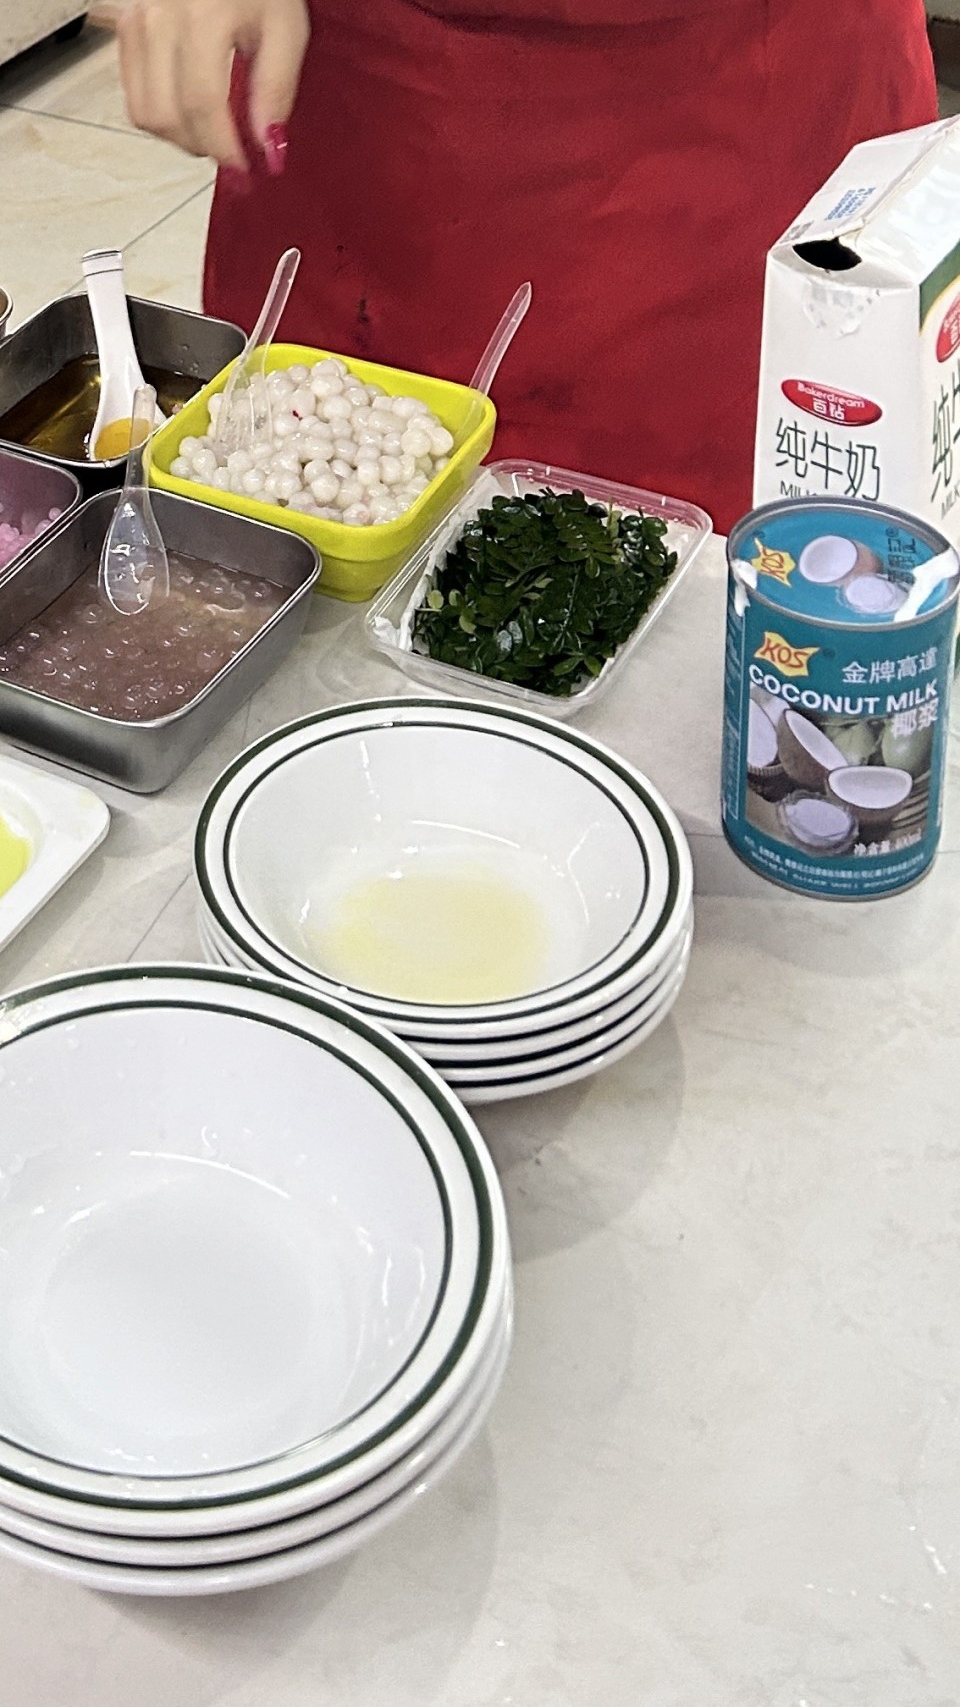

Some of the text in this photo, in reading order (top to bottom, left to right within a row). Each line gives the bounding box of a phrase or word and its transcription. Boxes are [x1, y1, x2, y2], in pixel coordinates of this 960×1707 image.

[797, 381, 865, 408] Bakerdream
[813, 397, 845, 421] 百钻
[775, 417, 881, 501] 纯牛奶
[760, 638, 808, 669] KOS
[748, 664, 939, 715] COCONUT MILK
